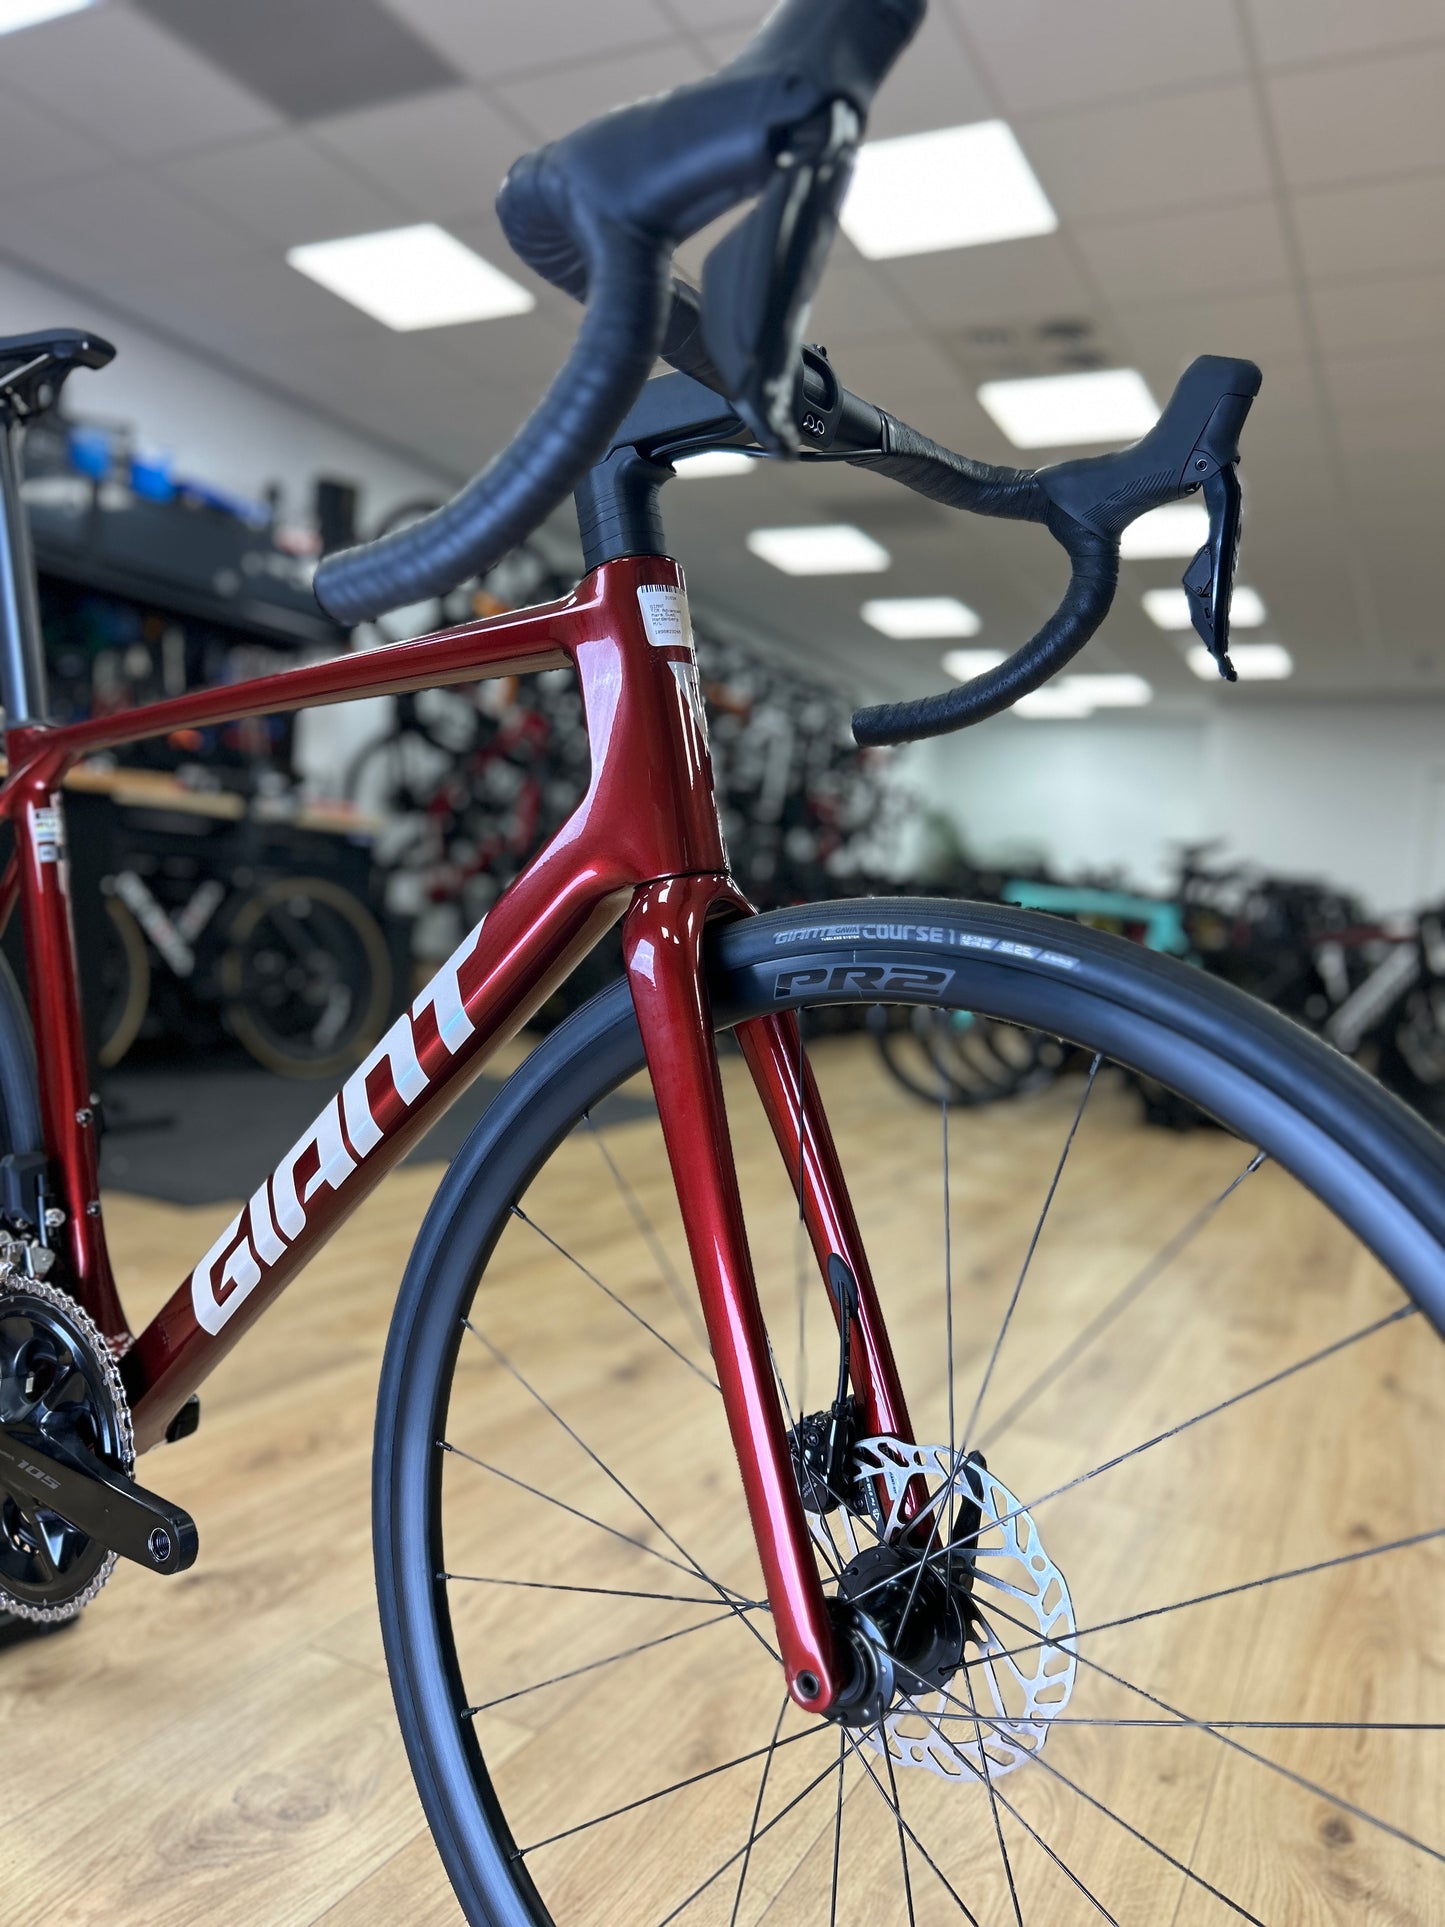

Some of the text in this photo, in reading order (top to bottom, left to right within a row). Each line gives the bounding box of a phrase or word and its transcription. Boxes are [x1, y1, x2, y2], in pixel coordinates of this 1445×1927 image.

[773, 926, 832, 945] GIANT
[862, 924, 944, 944] COURSE
[776, 965, 950, 998] PR2
[191, 911, 489, 1336] GIANT
[17, 1460, 61, 1490] 105
